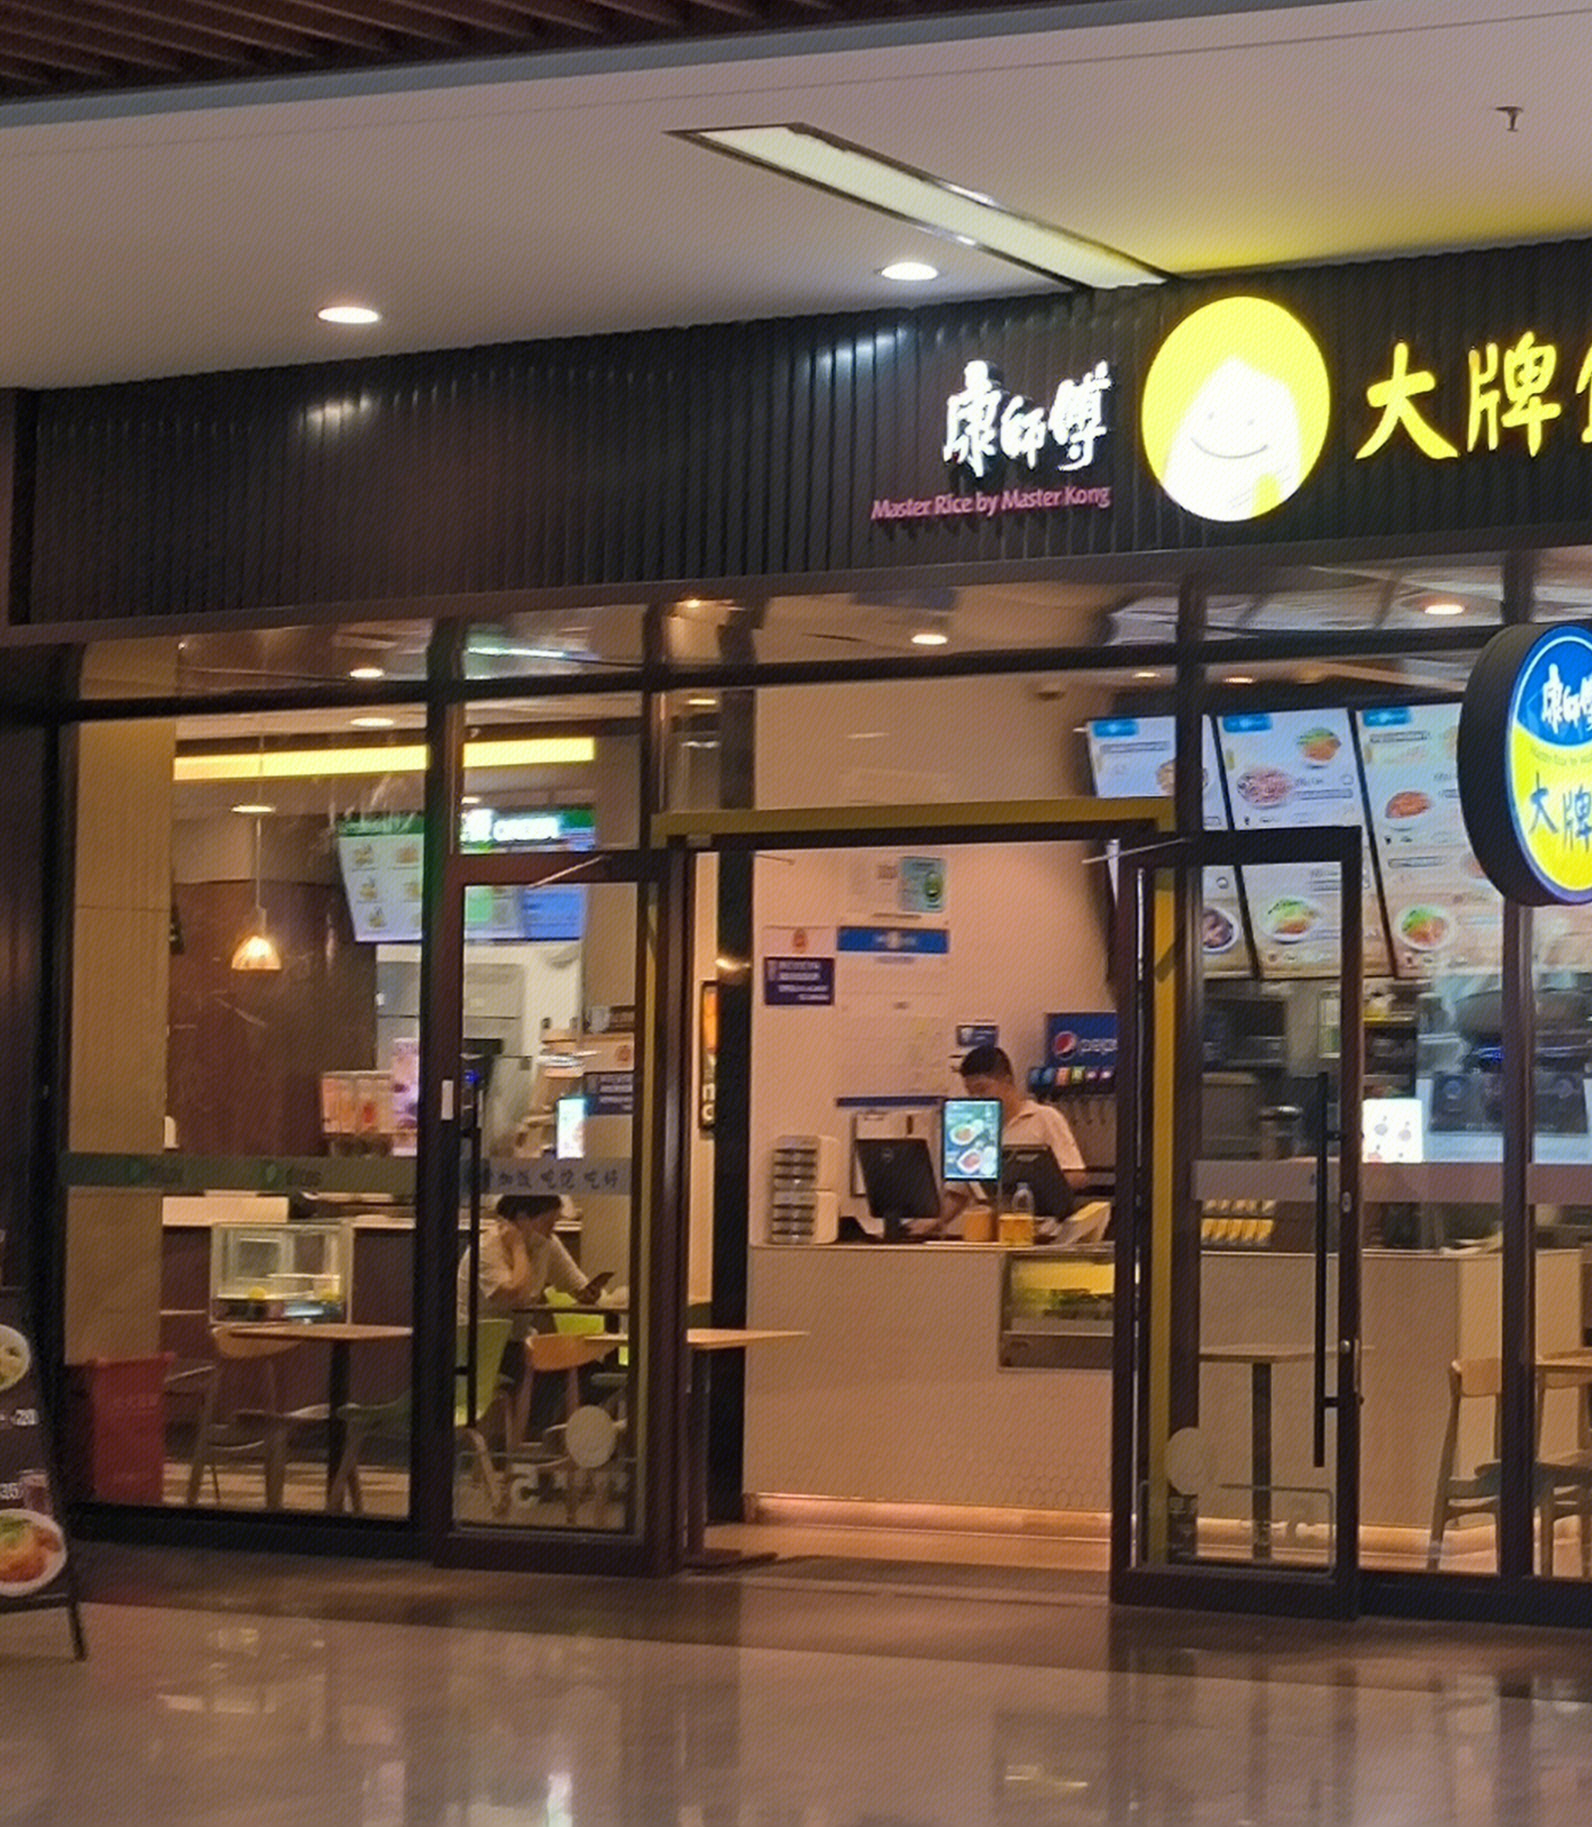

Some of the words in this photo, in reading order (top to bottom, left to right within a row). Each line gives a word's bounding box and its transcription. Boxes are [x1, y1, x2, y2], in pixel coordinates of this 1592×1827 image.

[870, 496, 931, 520] Master
[934, 493, 974, 516] Rice
[975, 491, 999, 517] by
[1001, 487, 1063, 511] Master
[1064, 485, 1112, 510] Kong
